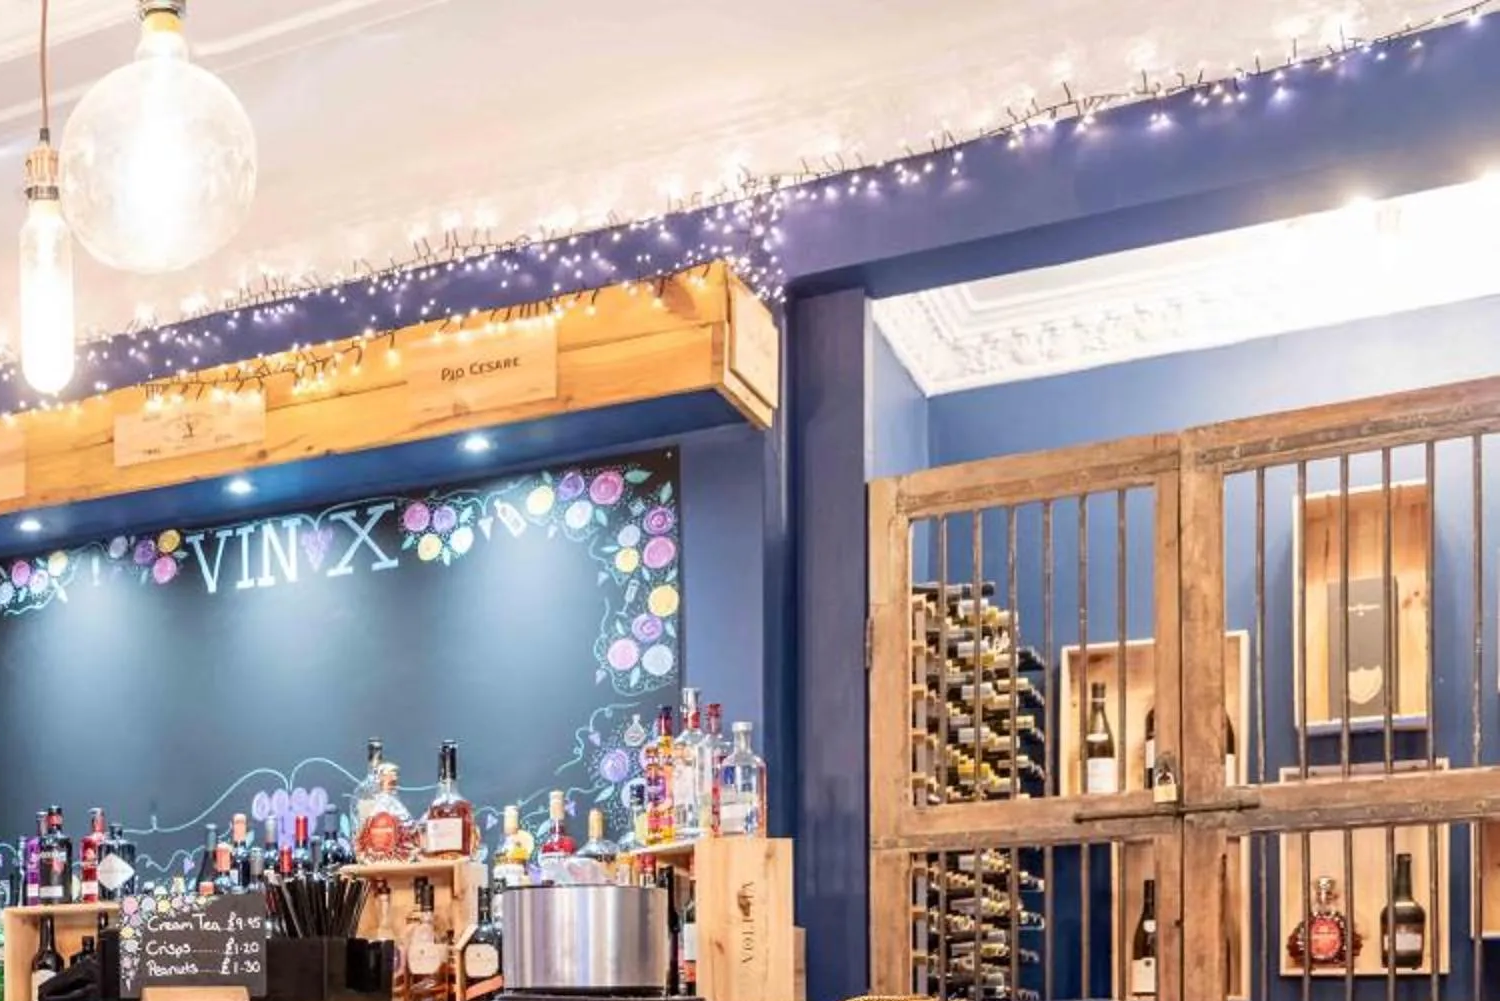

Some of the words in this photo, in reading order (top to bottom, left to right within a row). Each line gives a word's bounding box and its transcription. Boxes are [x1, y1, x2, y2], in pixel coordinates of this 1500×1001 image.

[469, 357, 520, 375] CESARE
[186, 518, 301, 594] VIN
[327, 502, 399, 578] X
[147, 915, 193, 932] Cream
[191, 913, 221, 932] Tea
[145, 940, 191, 958] Crisps
[146, 959, 199, 977] Peanuts
